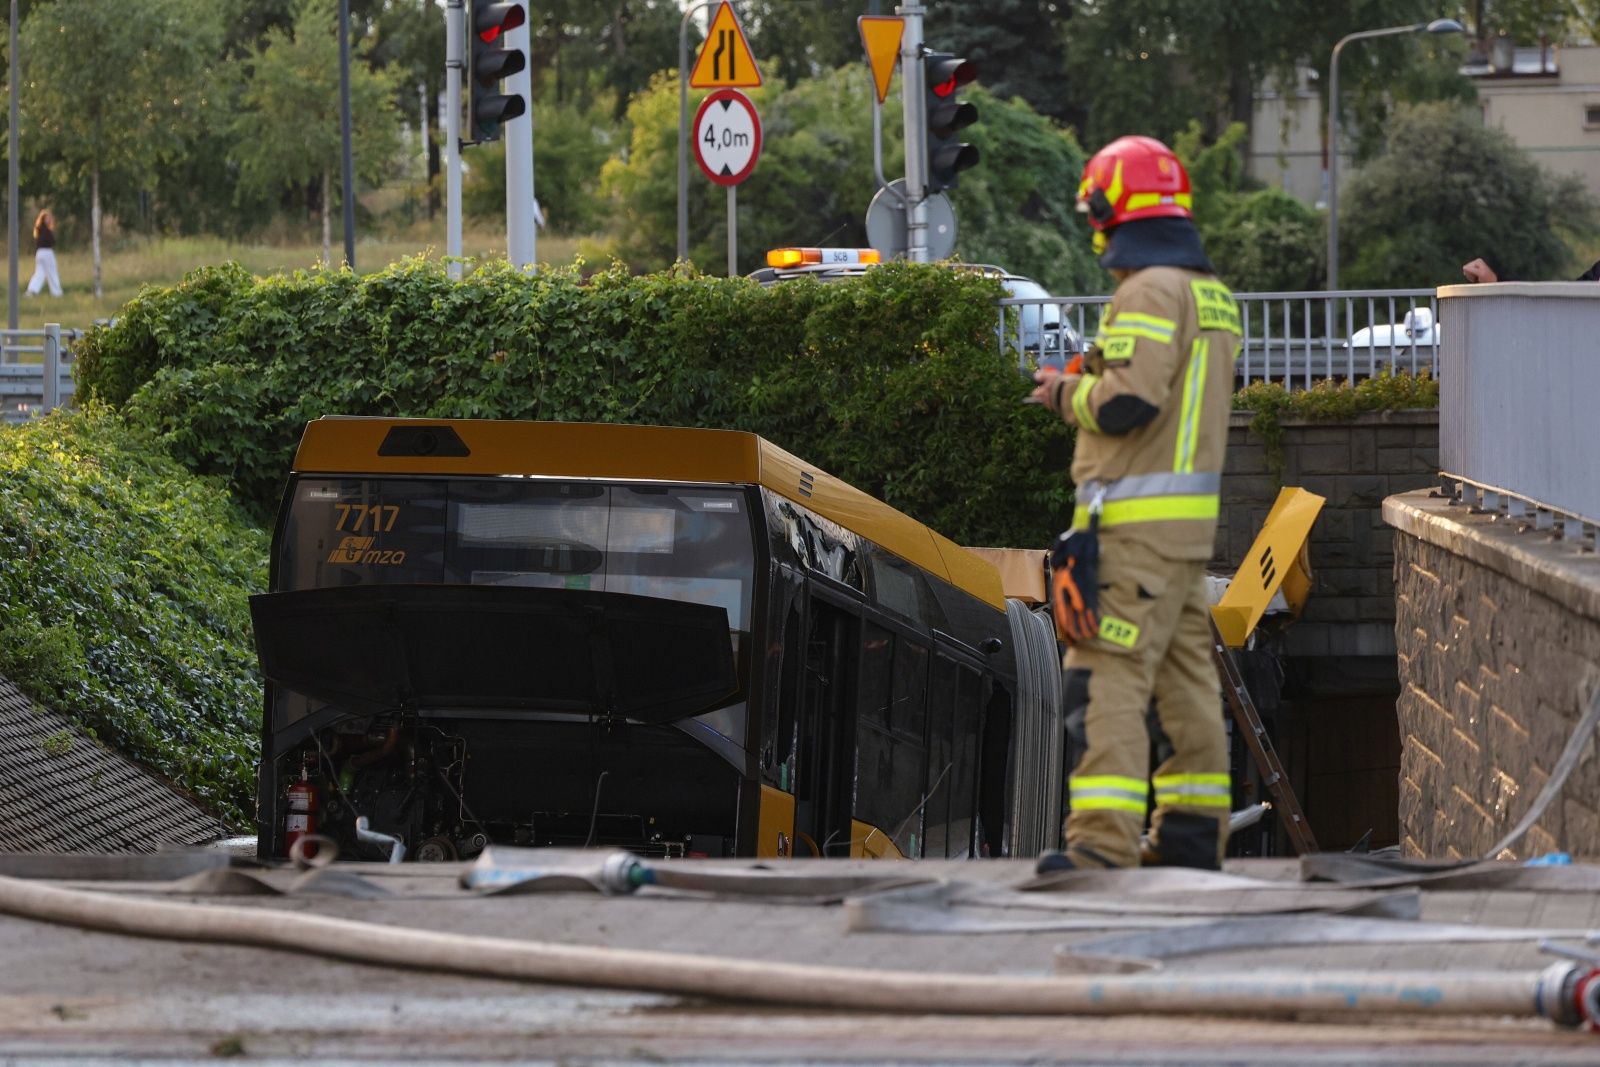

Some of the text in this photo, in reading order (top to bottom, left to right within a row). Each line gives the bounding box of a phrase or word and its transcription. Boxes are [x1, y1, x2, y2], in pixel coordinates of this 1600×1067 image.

[704, 124, 749, 152] 4,0m
[335, 503, 400, 532] 7717
[361, 549, 406, 565] mza
